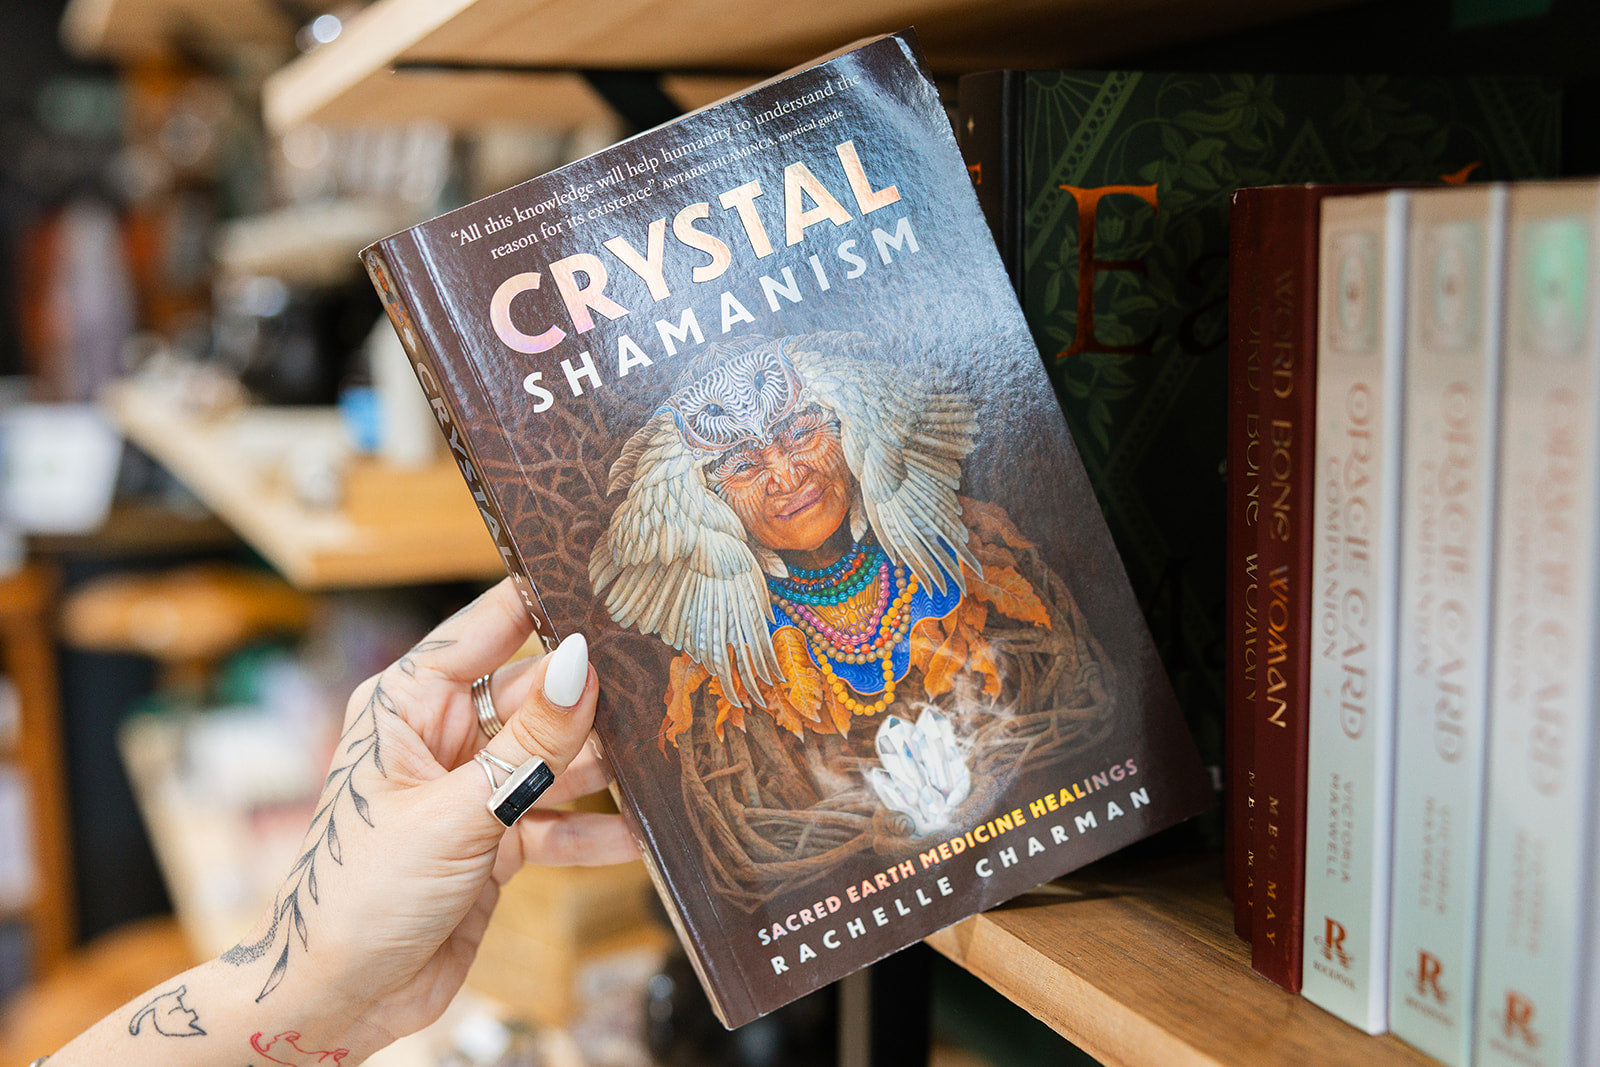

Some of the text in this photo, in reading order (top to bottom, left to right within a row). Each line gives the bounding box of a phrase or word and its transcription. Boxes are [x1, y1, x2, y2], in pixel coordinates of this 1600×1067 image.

[484, 214, 514, 236] this
[513, 182, 596, 223] knowledge
[596, 166, 625, 188] will
[625, 154, 659, 178] help
[661, 125, 732, 164] humanity
[735, 119, 752, 133] to
[754, 82, 835, 125] understand
[837, 72, 862, 92] the
[490, 232, 540, 260] reason
[540, 222, 564, 240] for
[564, 214, 586, 229] its
[662, 163, 711, 190] ANTARKI
[712, 137, 778, 170] HUAMINCA,
[779, 118, 817, 142] mystical
[817, 109, 844, 129] guide
[490, 140, 902, 355] CRYSTAL
[522, 216, 920, 413] SHAMANISM
[416, 361, 514, 571] CRYSTAL
[1266, 269, 1294, 728] WORD BONE WOMAN
[1321, 456, 1341, 661] COMPANION
[1340, 587, 1370, 741] CARD
[757, 758, 1140, 947] SACRED EARTH MEDICINE HEALINGS
[770, 787, 1152, 976] RACHELLE CHARMAN
[1265, 878, 1278, 947] MAY
